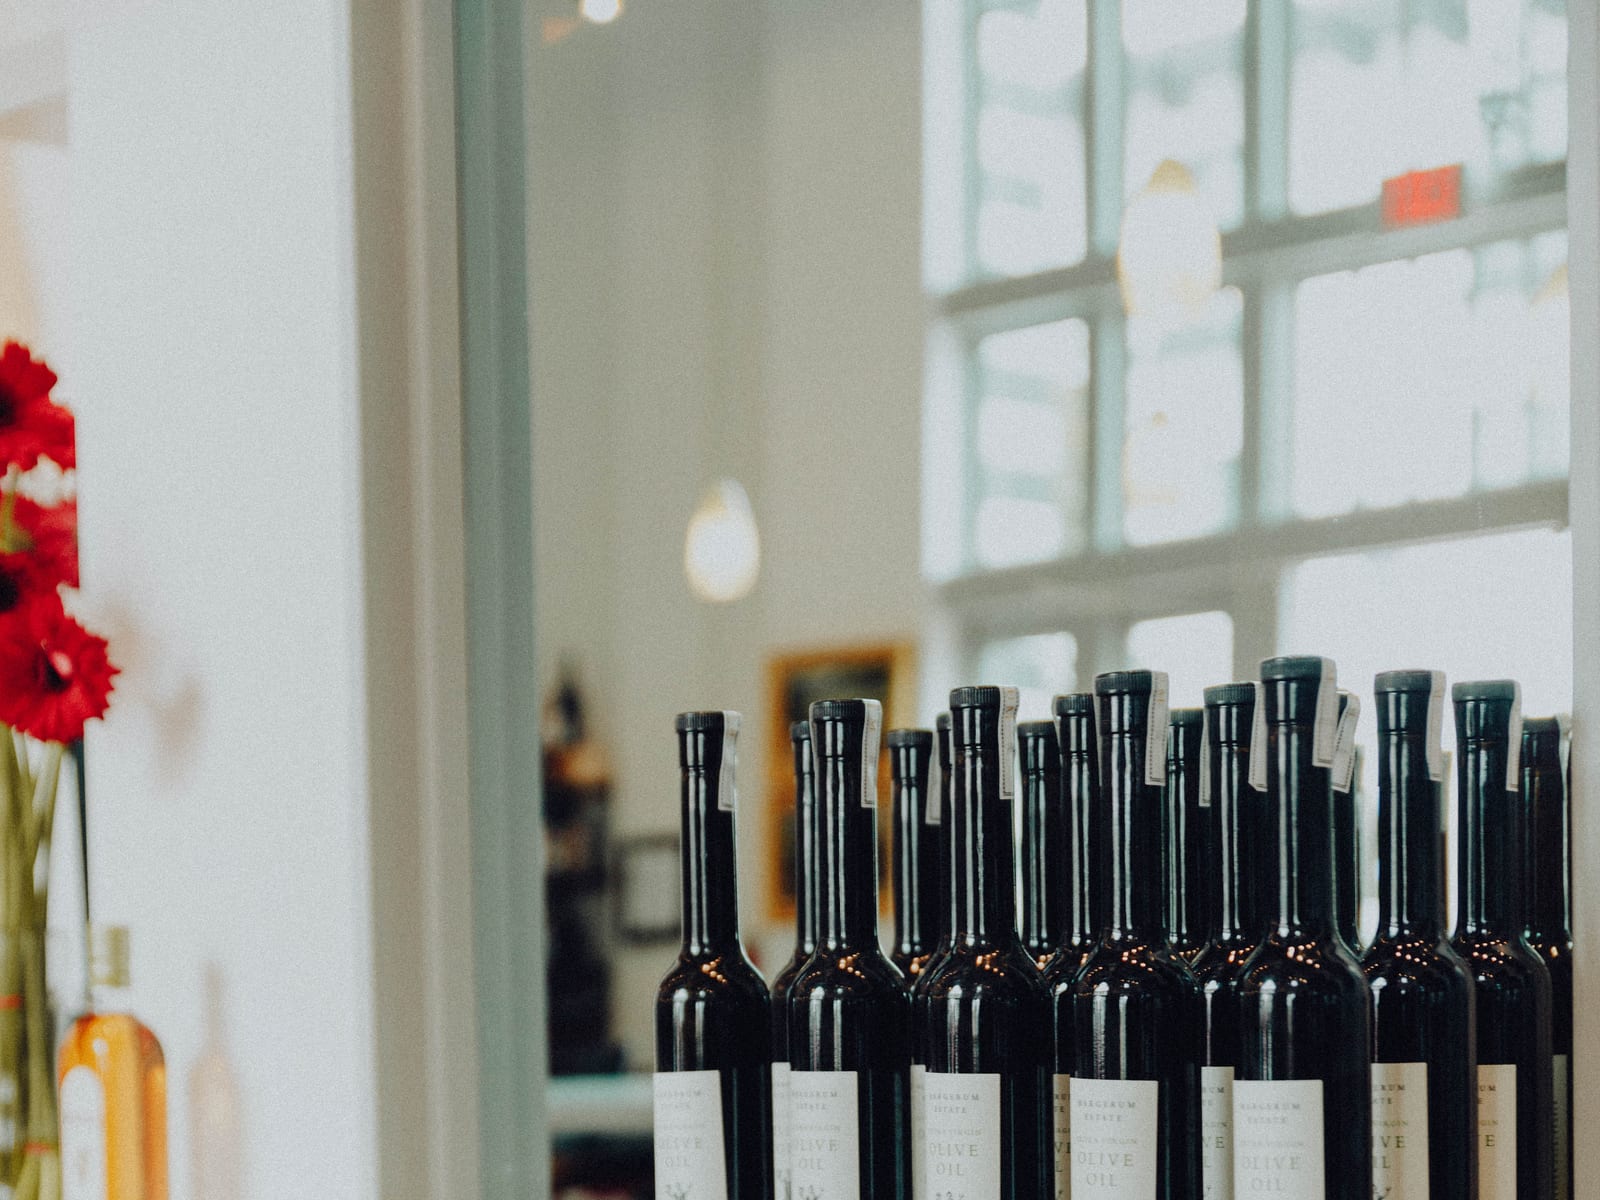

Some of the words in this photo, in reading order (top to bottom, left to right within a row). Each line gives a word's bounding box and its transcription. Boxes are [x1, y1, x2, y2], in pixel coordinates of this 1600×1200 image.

[929, 1143, 979, 1157] OLIVE
[1077, 1151, 1134, 1167] OLIVE
[1242, 1155, 1301, 1170] OLIVE
[936, 1163, 965, 1176] OIL
[1086, 1172, 1117, 1187] OIL
[1251, 1177, 1284, 1192] OIL
